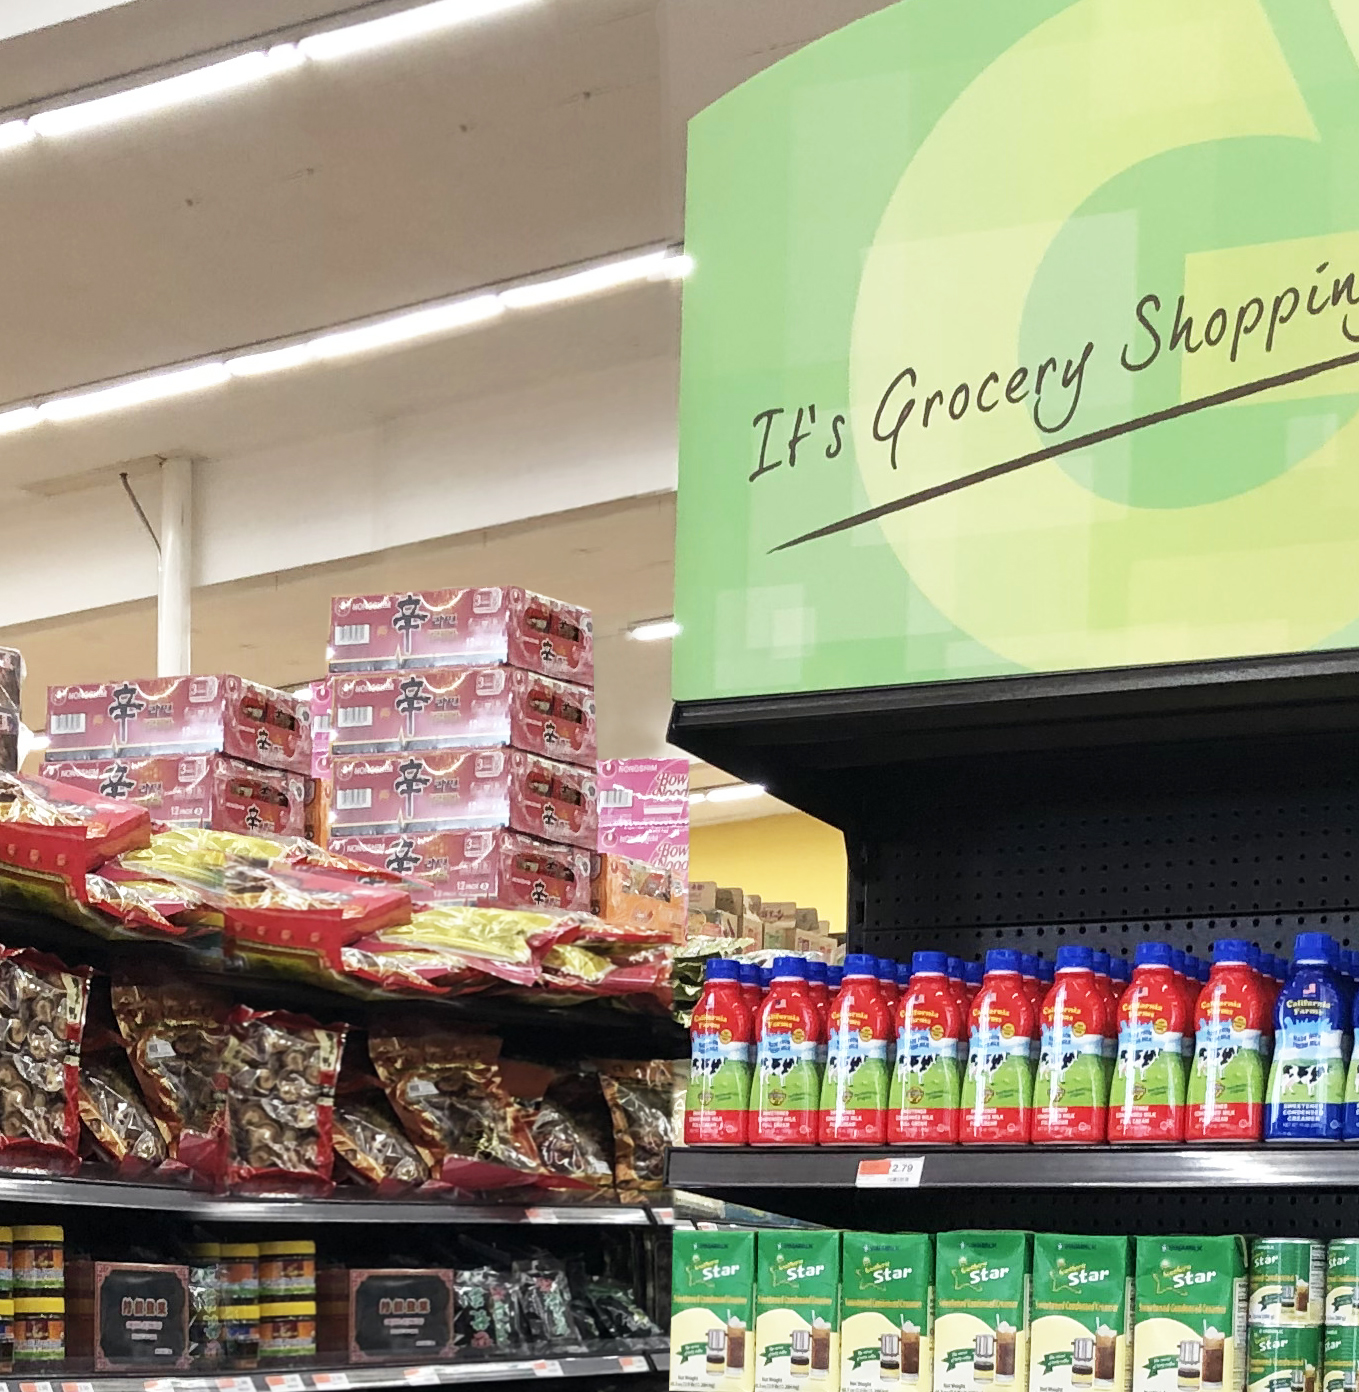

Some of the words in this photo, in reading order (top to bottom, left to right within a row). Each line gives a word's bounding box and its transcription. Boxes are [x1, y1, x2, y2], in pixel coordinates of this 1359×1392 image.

[749, 405, 846, 484] It's
[871, 336, 1095, 468] Grocery
[702, 1263, 739, 1281] Star
[873, 1266, 912, 1283] Star
[970, 1266, 1009, 1284] Star
[1068, 1268, 1109, 1286] Star
[1173, 1269, 1216, 1288] Star
